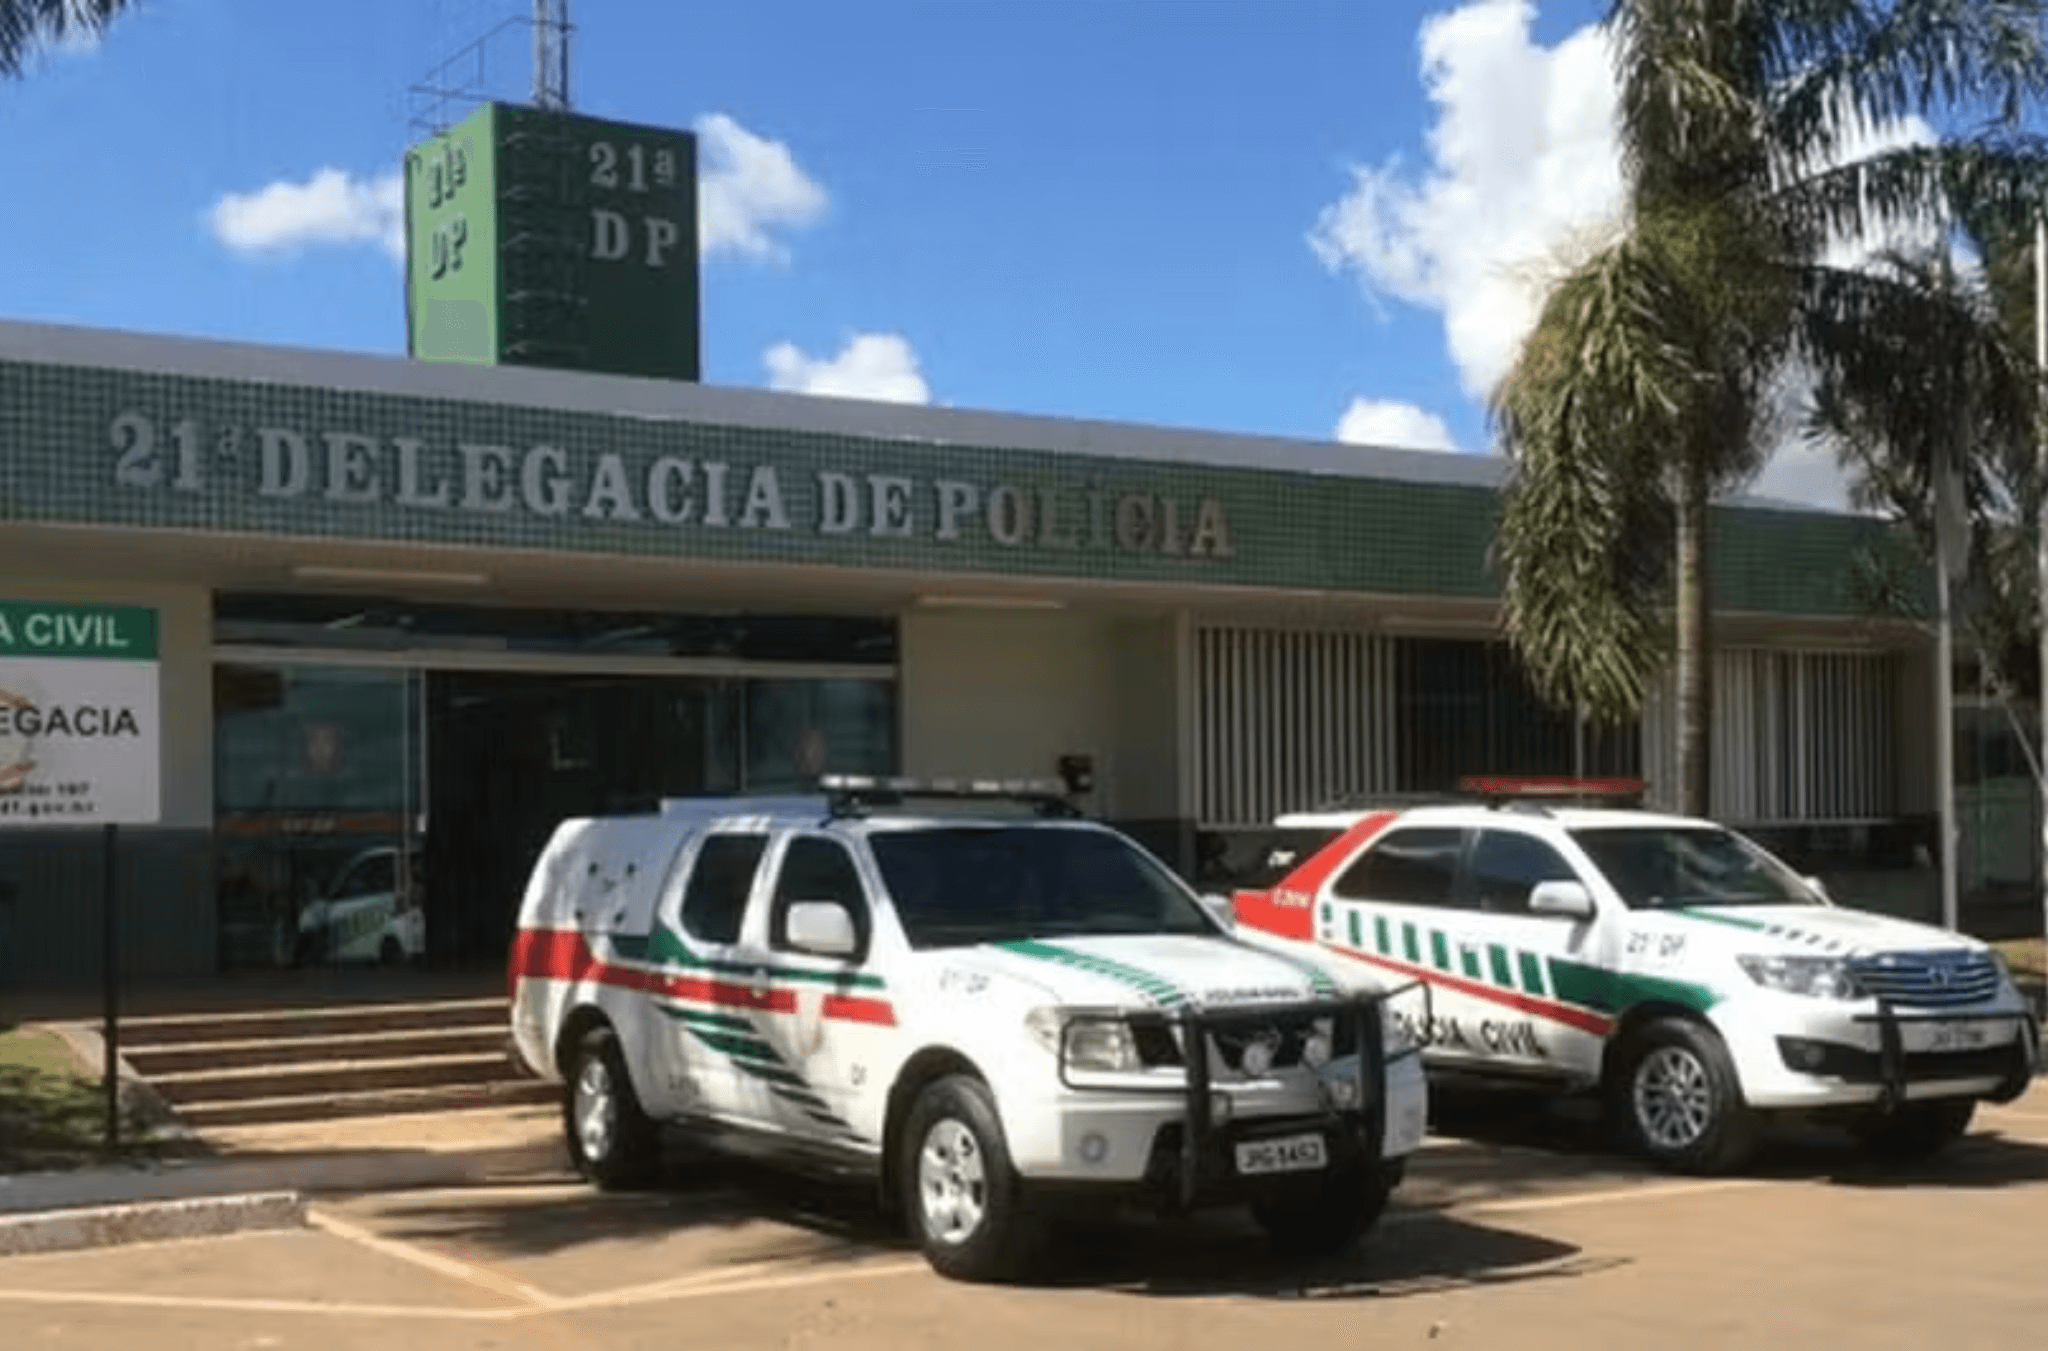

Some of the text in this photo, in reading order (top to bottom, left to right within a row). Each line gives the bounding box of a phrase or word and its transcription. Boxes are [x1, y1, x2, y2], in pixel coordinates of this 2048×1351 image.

[591, 208, 677, 267] DP
[257, 427, 791, 530] DELEGACIA
[819, 470, 914, 538] DE
[24, 612, 130, 648] CIVIL
